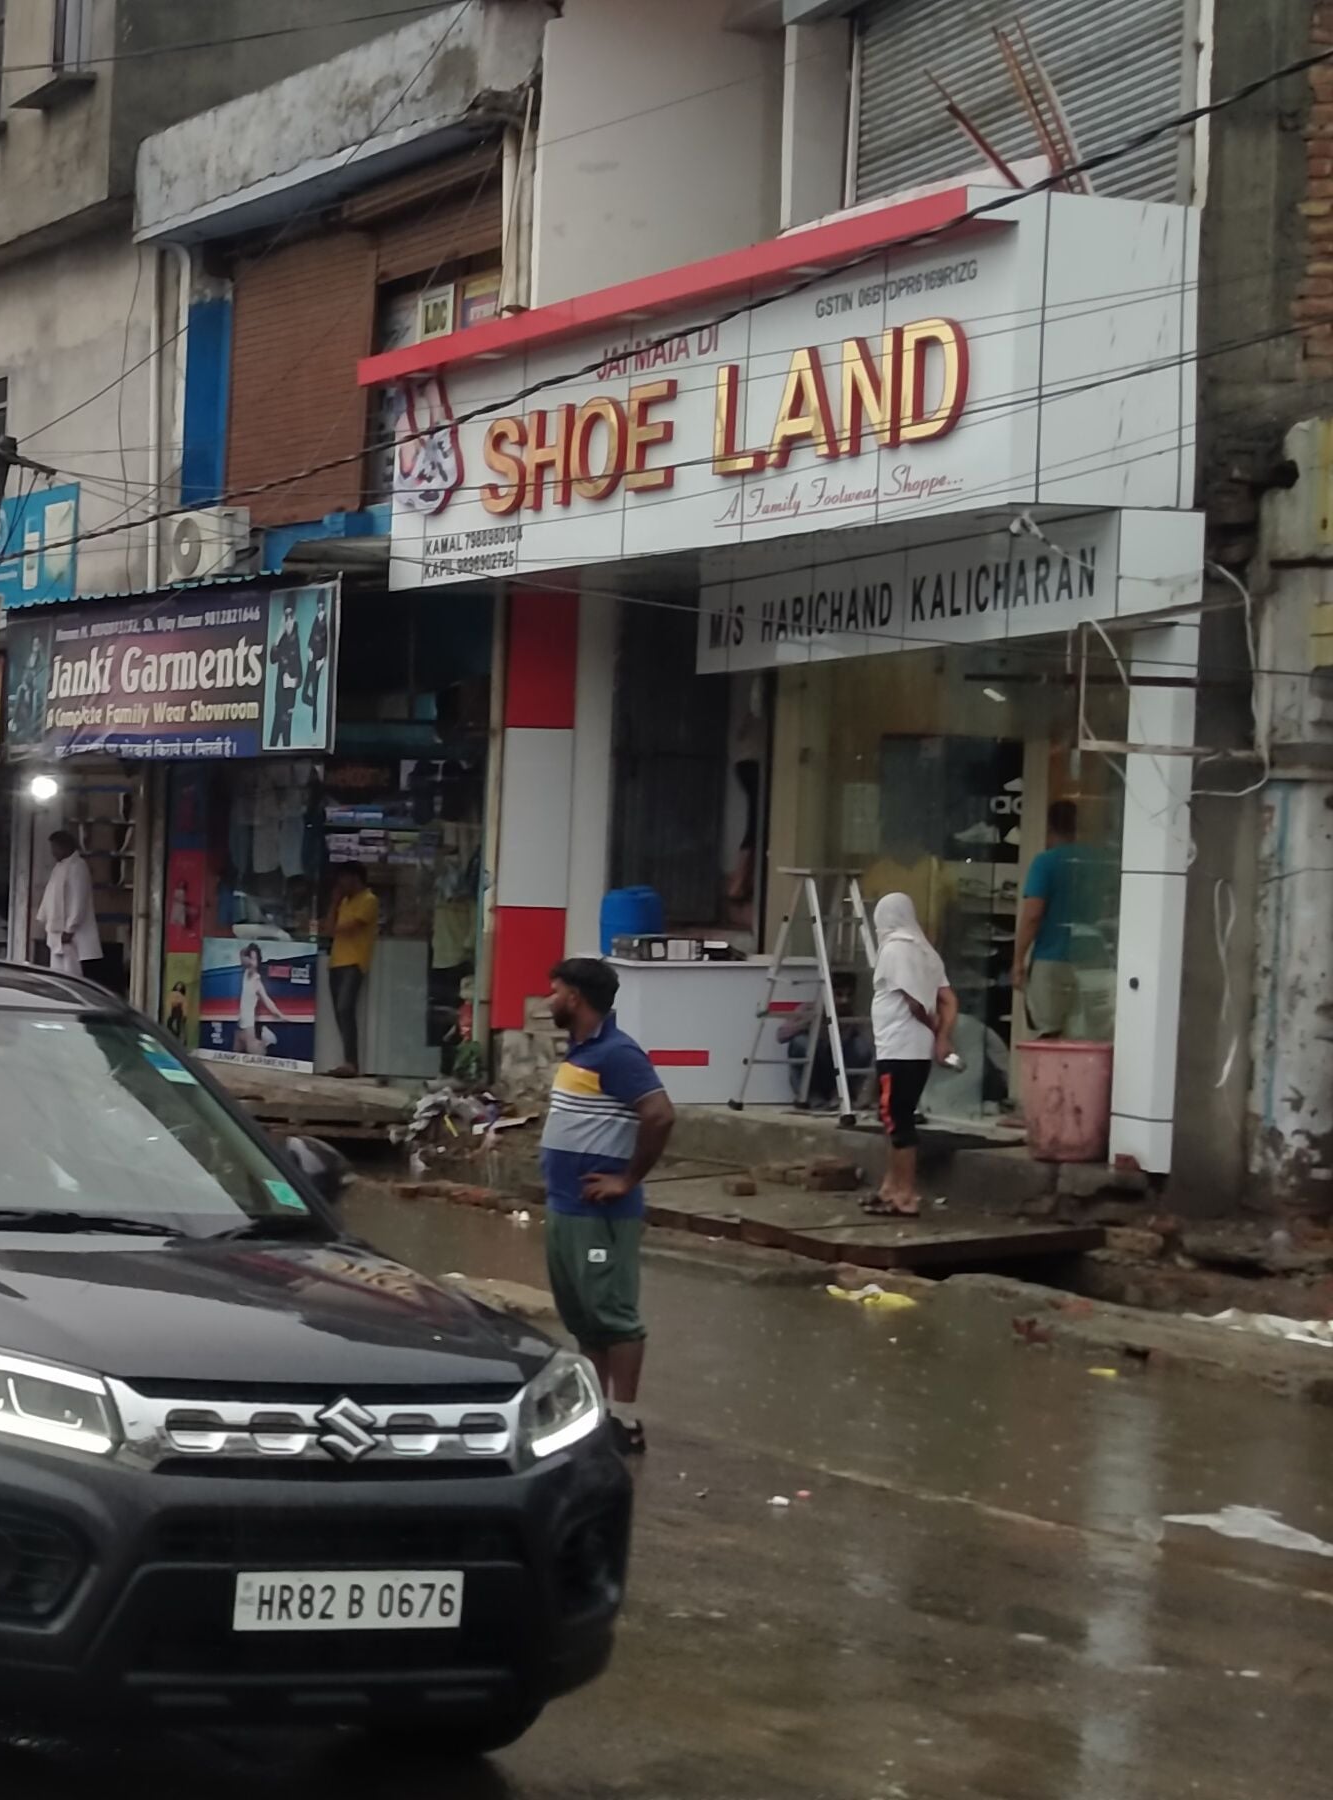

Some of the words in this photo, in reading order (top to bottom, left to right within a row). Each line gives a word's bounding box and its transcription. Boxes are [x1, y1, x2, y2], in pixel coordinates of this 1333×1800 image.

[815, 291, 853, 318] GSTIN
[597, 344, 628, 380] JAI
[697, 323, 720, 356] DI
[482, 378, 678, 517] SHOE
[712, 317, 970, 476] LAND
[714, 492, 740, 522] A
[747, 482, 801, 517] Family
[425, 535, 462, 556] KAMAL
[709, 603, 745, 650] M/S
[760, 581, 893, 643] HARICHAND
[911, 545, 1096, 623] KALICHARAN
[47, 644, 118, 700] Janki
[120, 636, 263, 693] Garments
[105, 702, 149, 729] Family
[153, 701, 186, 723] Wear
[189, 700, 260, 723] Showroom
[256, 1583, 337, 1621] HR82
[347, 1583, 365, 1620] B
[377, 1582, 457, 1619] 0676
